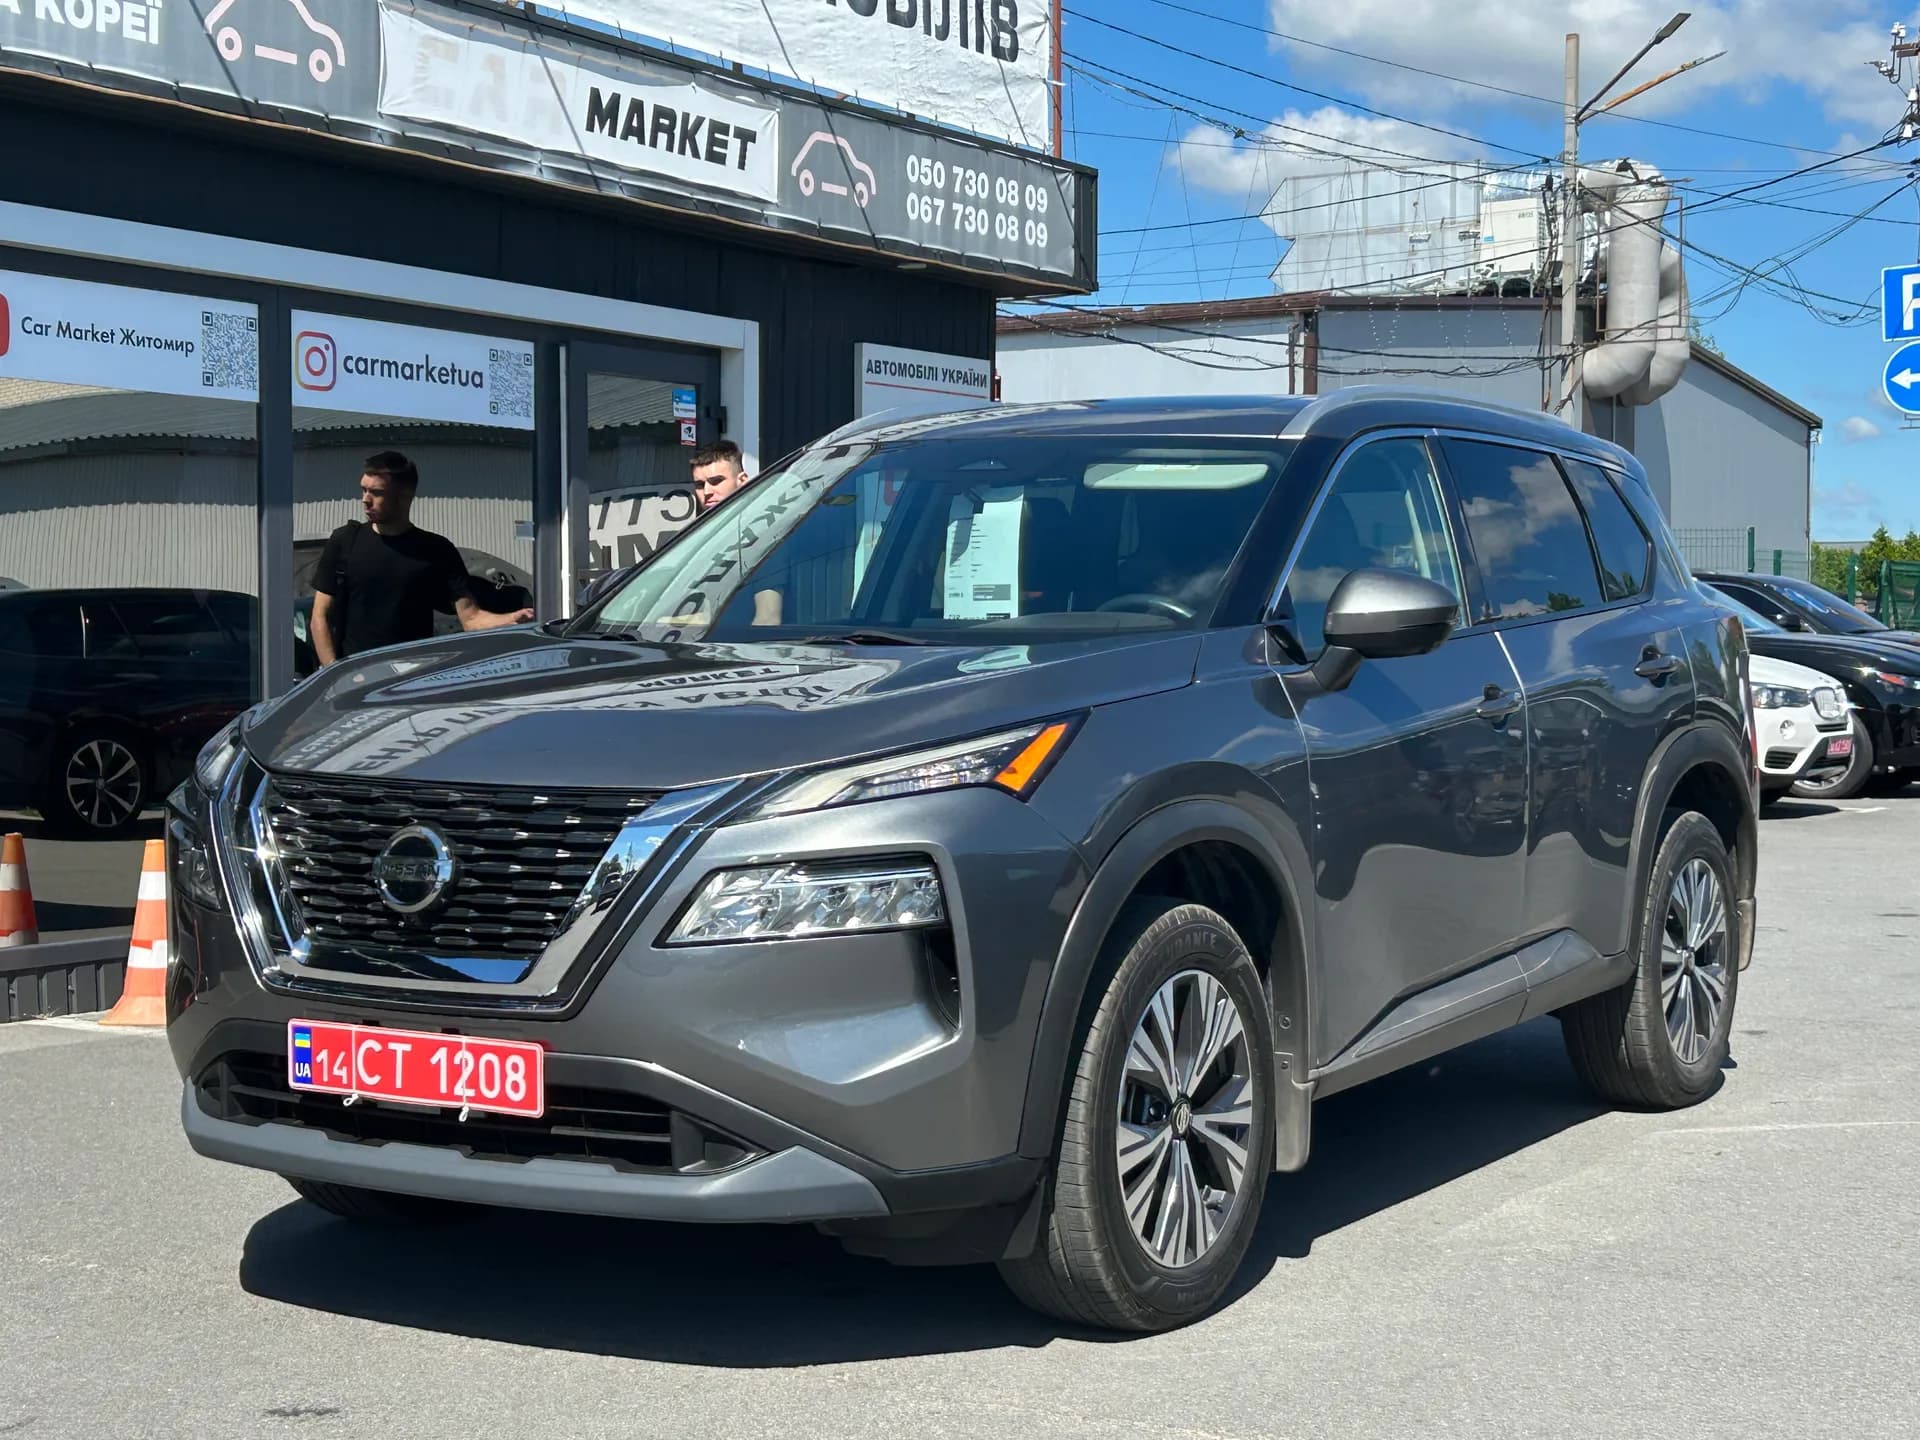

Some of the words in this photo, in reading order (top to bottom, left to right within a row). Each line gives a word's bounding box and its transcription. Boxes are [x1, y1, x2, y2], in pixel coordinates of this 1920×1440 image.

[585, 86, 757, 171] MARKET
[906, 154, 946, 189] 050
[952, 166, 989, 200] 730
[995, 176, 1020, 205] 08
[1025, 184, 1048, 214] 09
[906, 192, 945, 226] 067
[952, 202, 989, 236] 730
[995, 213, 1019, 242] 08
[1025, 219, 1048, 248] 09
[21, 316, 51, 337] Car
[56, 320, 115, 345] Market
[120, 327, 195, 358] Житомир
[343, 354, 484, 389] carmarketua
[866, 359, 938, 381] АВТОМОБІЛІ
[941, 367, 987, 388] УКРАЇНИ
[295, 1062, 311, 1078] UA
[314, 1048, 348, 1085] 14
[356, 1039, 412, 1089] CT
[430, 1046, 526, 1102] 1208
